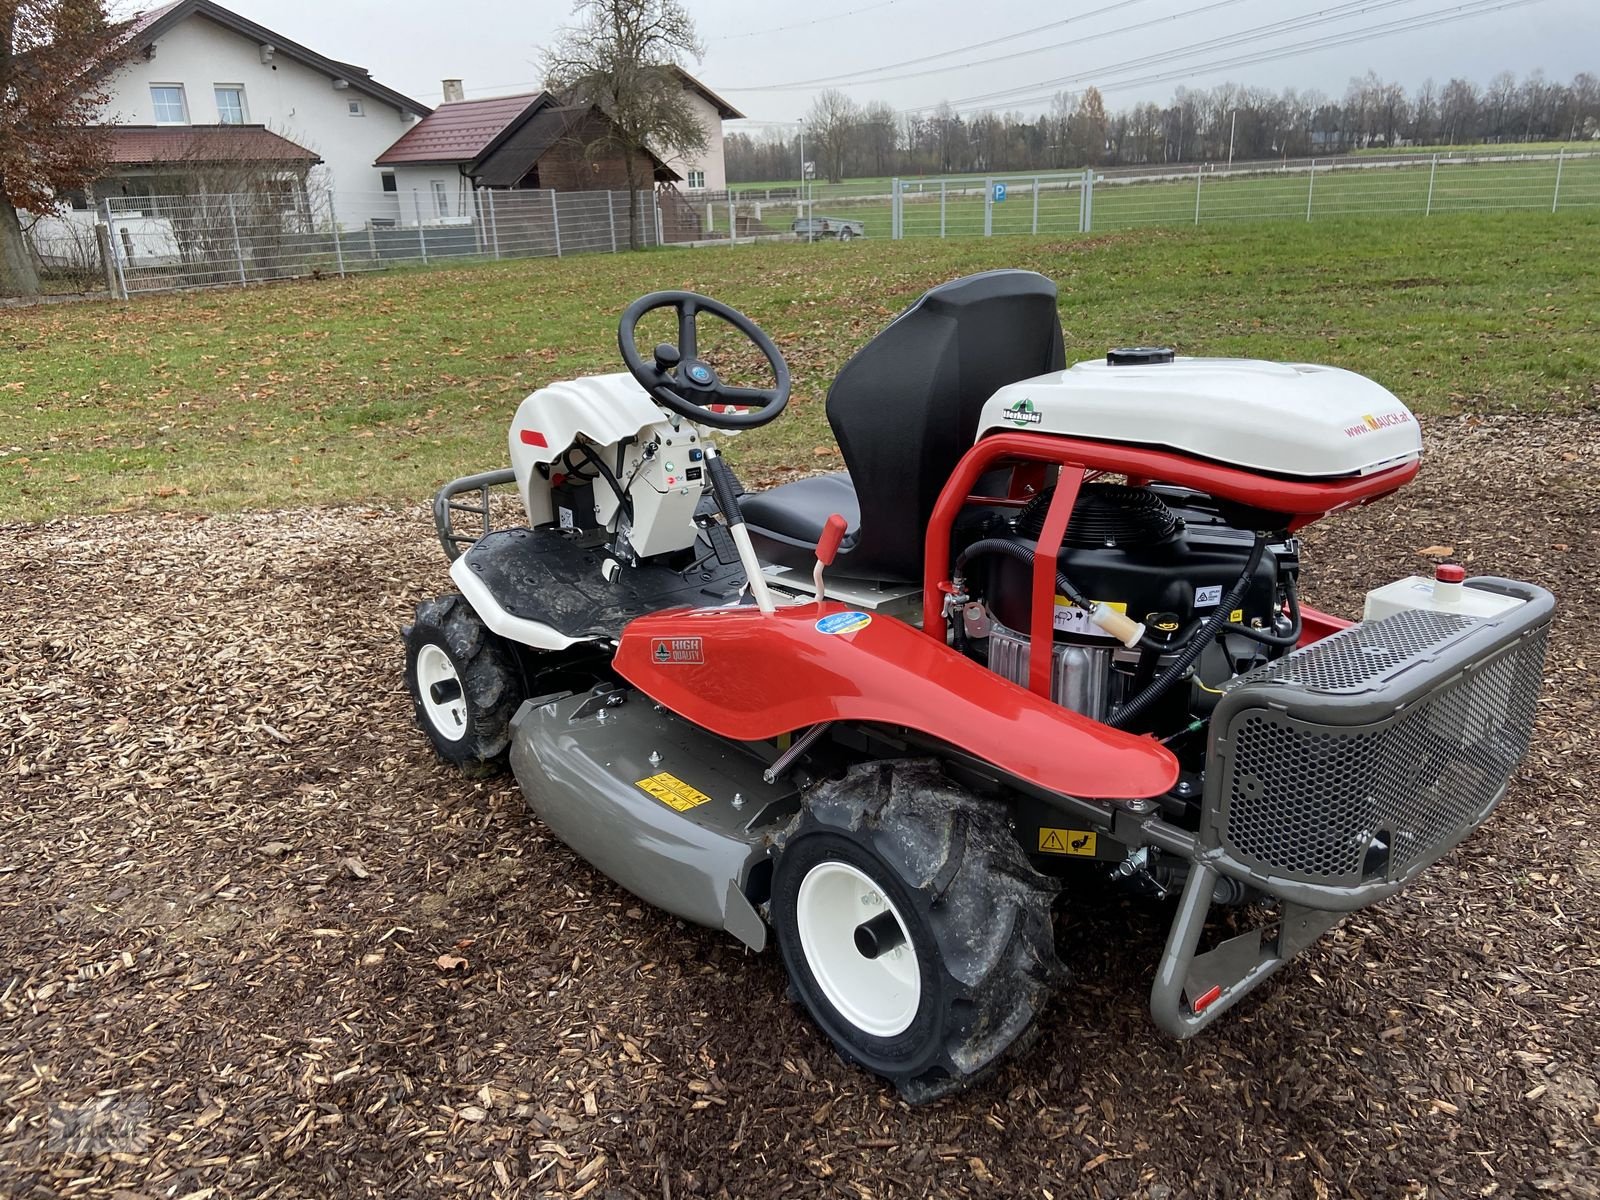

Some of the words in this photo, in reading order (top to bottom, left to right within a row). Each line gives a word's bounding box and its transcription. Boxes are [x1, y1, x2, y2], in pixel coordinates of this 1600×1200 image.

[995, 185, 1004, 200] P
[672, 640, 699, 650] HIGH
[672, 650, 699, 661] QUALITY
